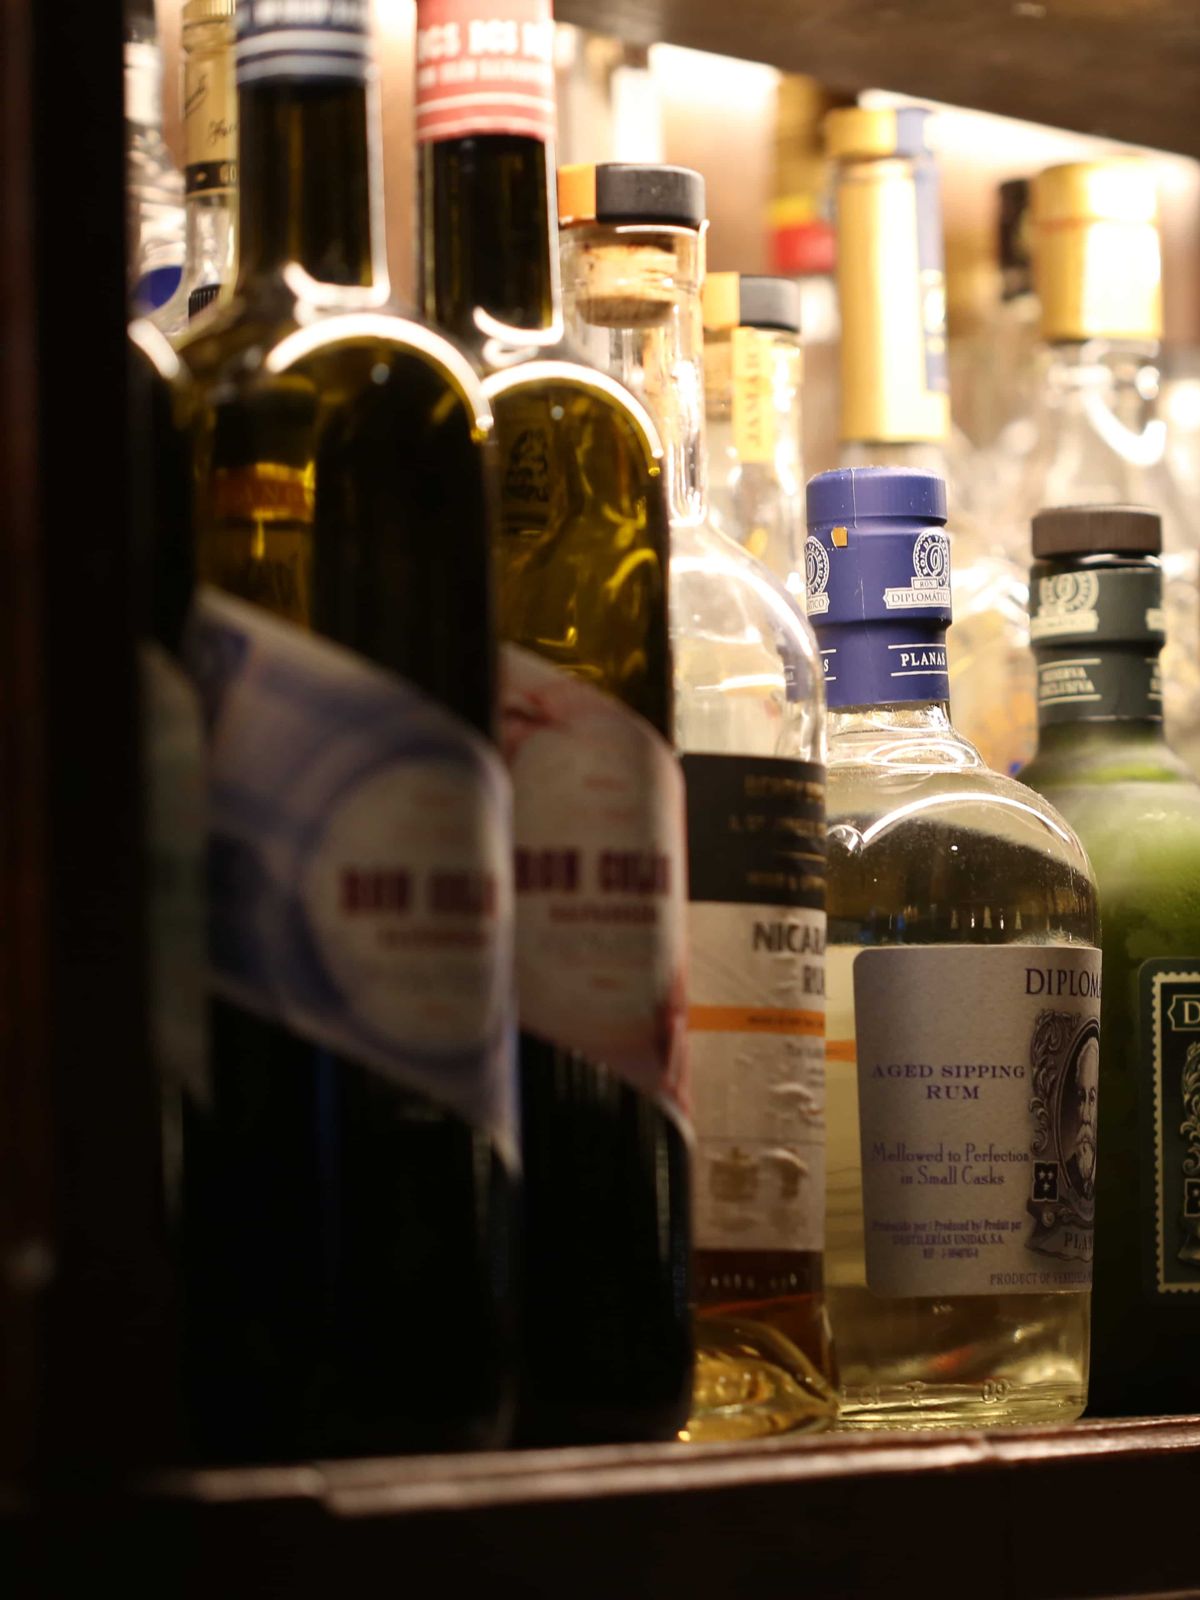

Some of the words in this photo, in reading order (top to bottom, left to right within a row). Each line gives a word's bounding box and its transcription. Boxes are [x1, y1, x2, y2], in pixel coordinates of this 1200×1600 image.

[900, 652, 946, 667] PLANAS
[1025, 967, 1100, 999] DIPLOM
[871, 1064, 934, 1079] AGED
[940, 1064, 1026, 1080] SIPPING
[926, 1085, 980, 1100] RUM
[871, 1142, 943, 1163] Mellowed
[948, 1148, 960, 1163] to
[965, 1142, 1029, 1163] Perfection
[900, 1172, 914, 1185] in
[917, 1165, 957, 1186] Small
[961, 1166, 1005, 1186] Casks
